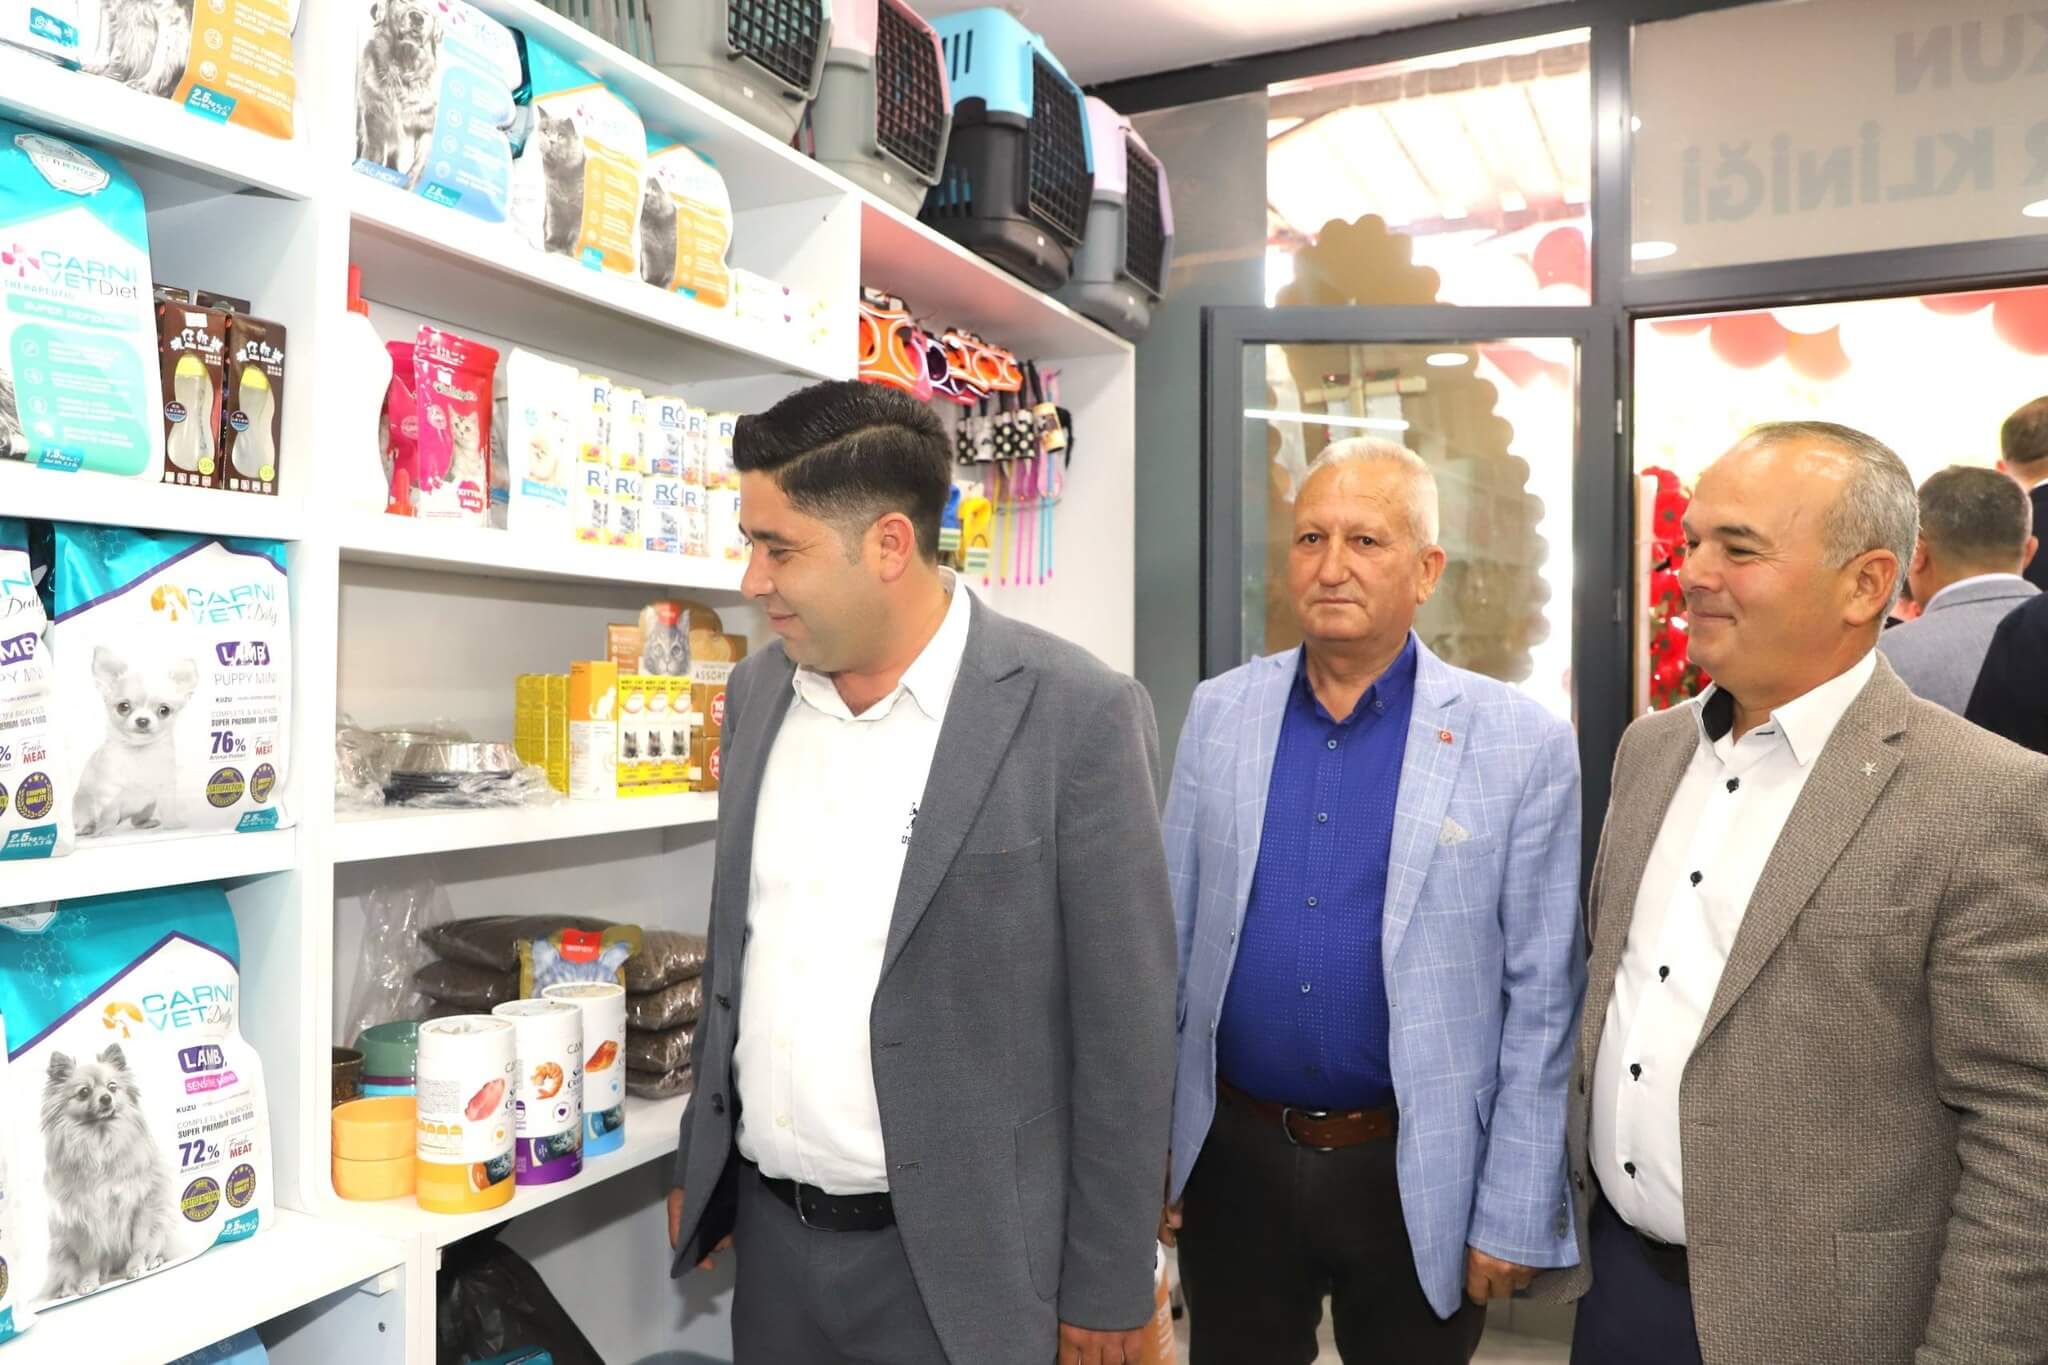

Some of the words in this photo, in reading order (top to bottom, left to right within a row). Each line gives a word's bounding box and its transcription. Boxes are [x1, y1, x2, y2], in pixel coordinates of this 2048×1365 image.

[41, 249, 138, 283] CARNI
[186, 583, 275, 608] CARNI
[214, 671, 252, 687] PUPPY
[22, 749, 47, 765] MEAT
[141, 983, 233, 1014] CARNI
[147, 1005, 208, 1031] VET
[183, 1048, 222, 1069] LAMB
[176, 1103, 197, 1114] KUZU
[177, 1127, 201, 1140] SUPER
[202, 1119, 229, 1134] PREMIUM
[228, 1142, 254, 1160] MEAT
